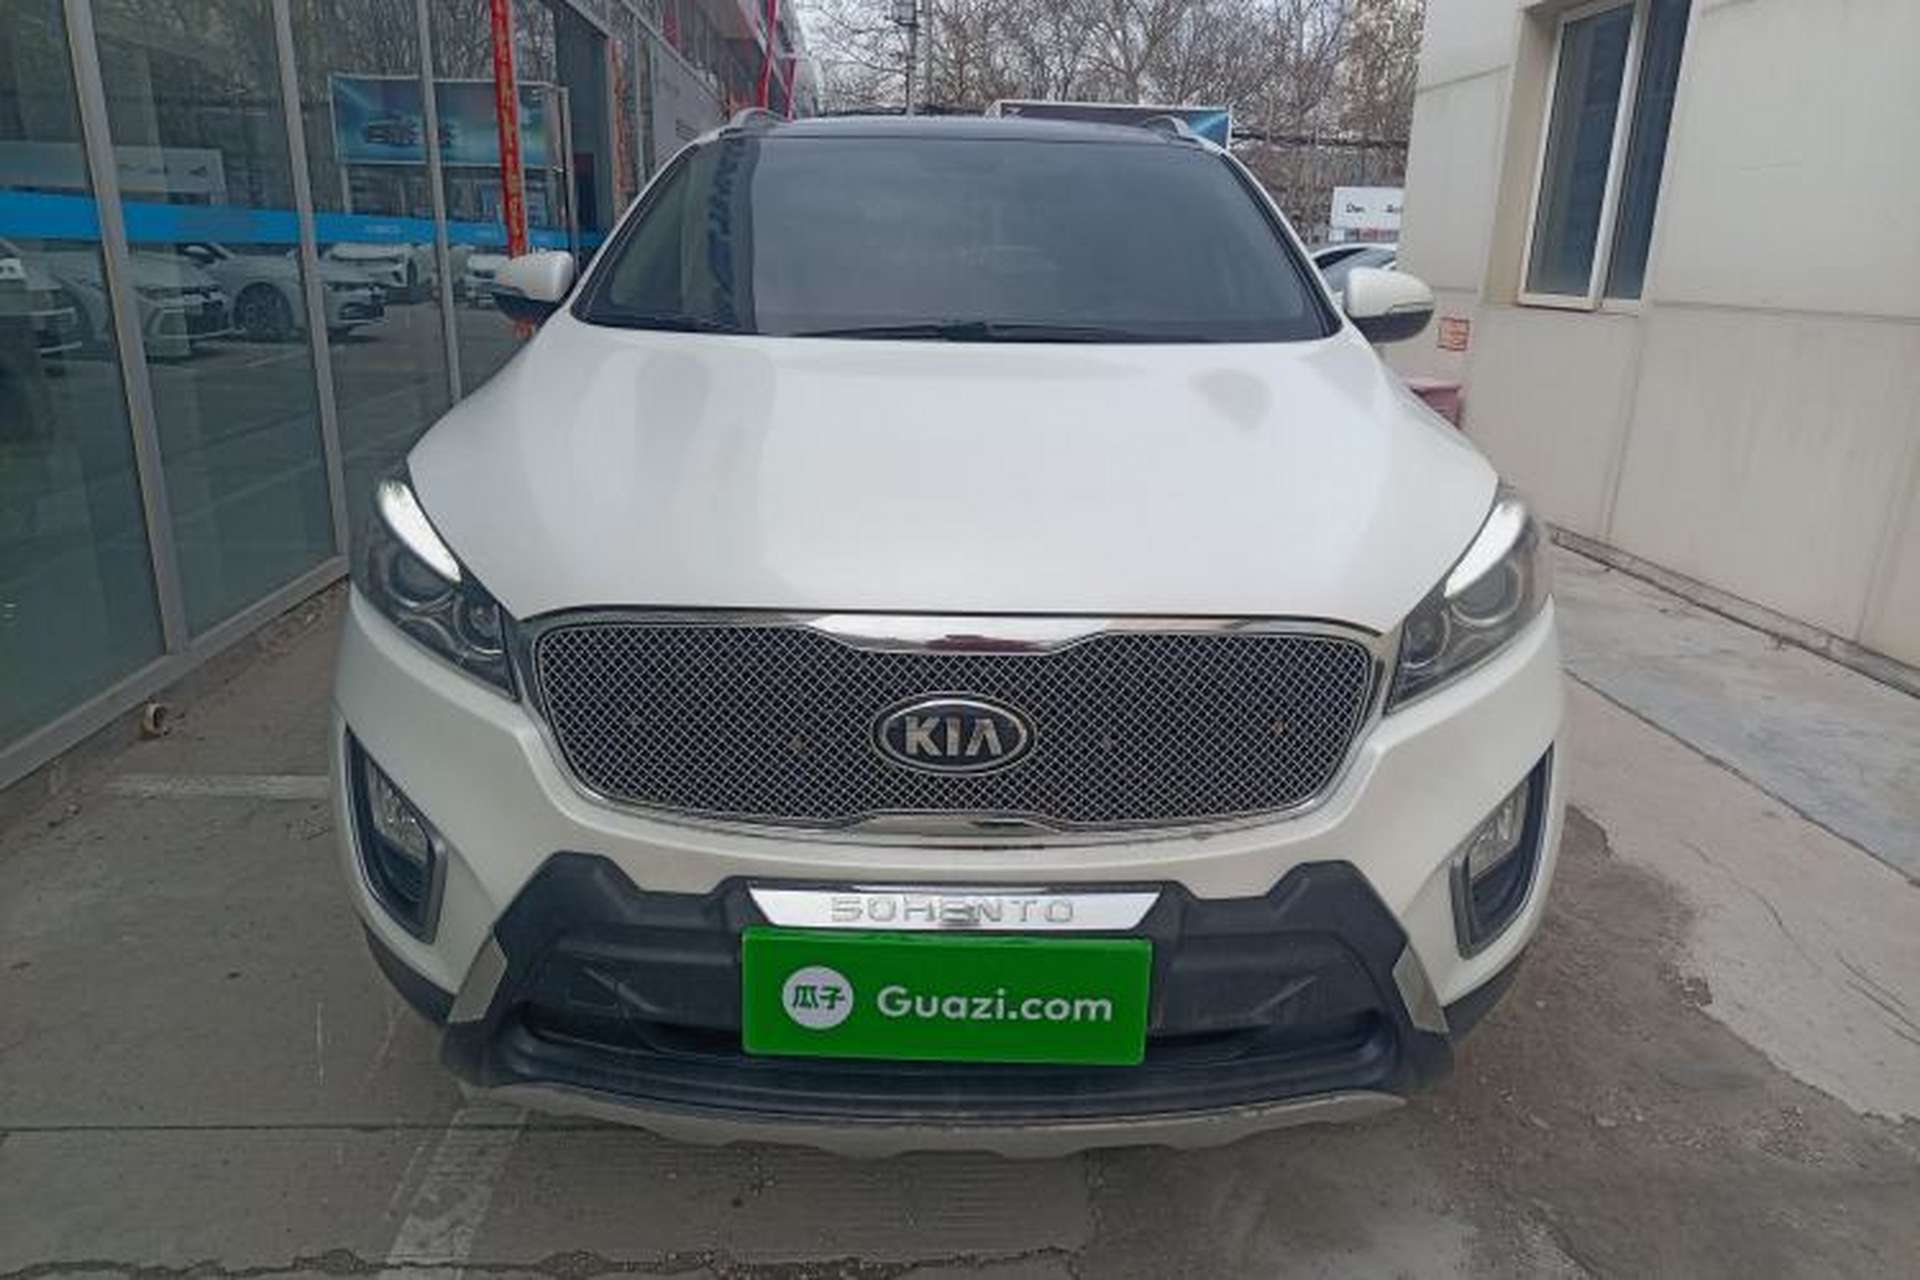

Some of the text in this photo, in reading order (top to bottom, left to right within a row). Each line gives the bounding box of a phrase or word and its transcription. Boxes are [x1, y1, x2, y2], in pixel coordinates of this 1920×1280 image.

[905, 716, 1002, 756] KIA
[831, 896, 1074, 922] SORENTO
[792, 985, 846, 1011] 瓜子
[877, 985, 1113, 1021] Guazi.com
